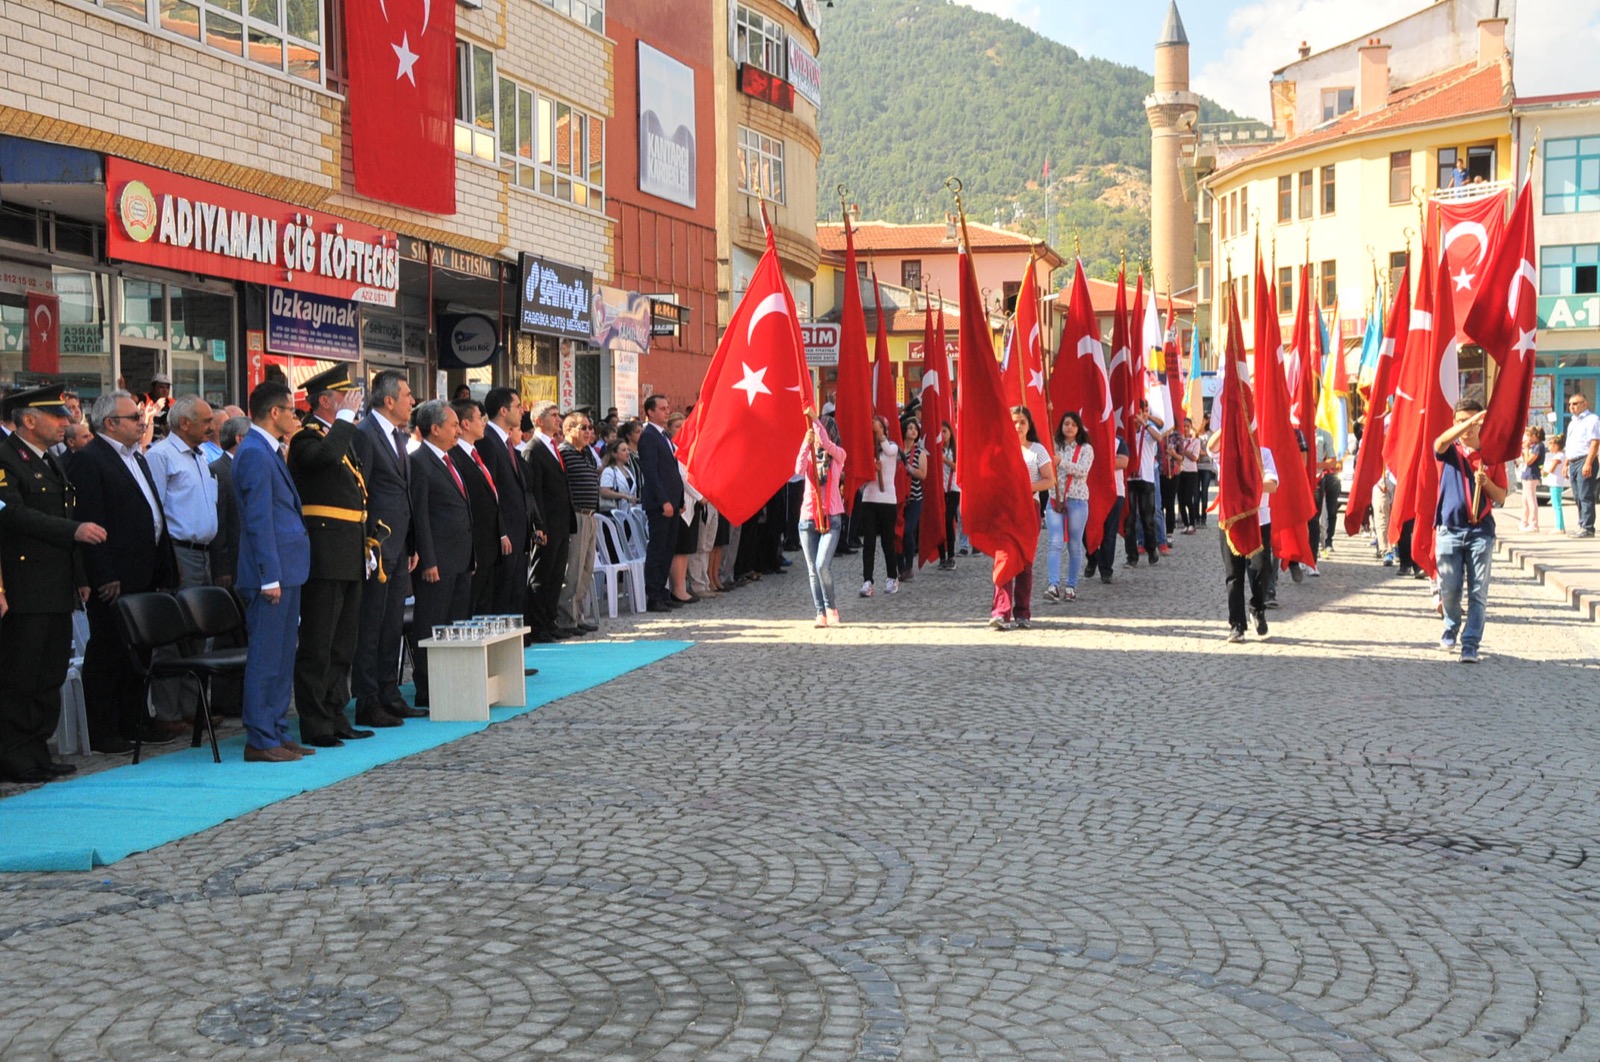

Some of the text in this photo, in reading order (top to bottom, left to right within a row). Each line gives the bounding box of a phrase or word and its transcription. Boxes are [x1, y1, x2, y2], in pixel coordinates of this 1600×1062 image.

[159, 193, 400, 291] ADIYAMAN ÇİĞ KÖFTECİSİ
[3, 273, 17, 284] 812
[18, 276, 27, 286] 15
[451, 250, 492, 277] İLETİŞİM
[562, 360, 573, 408] STARS
